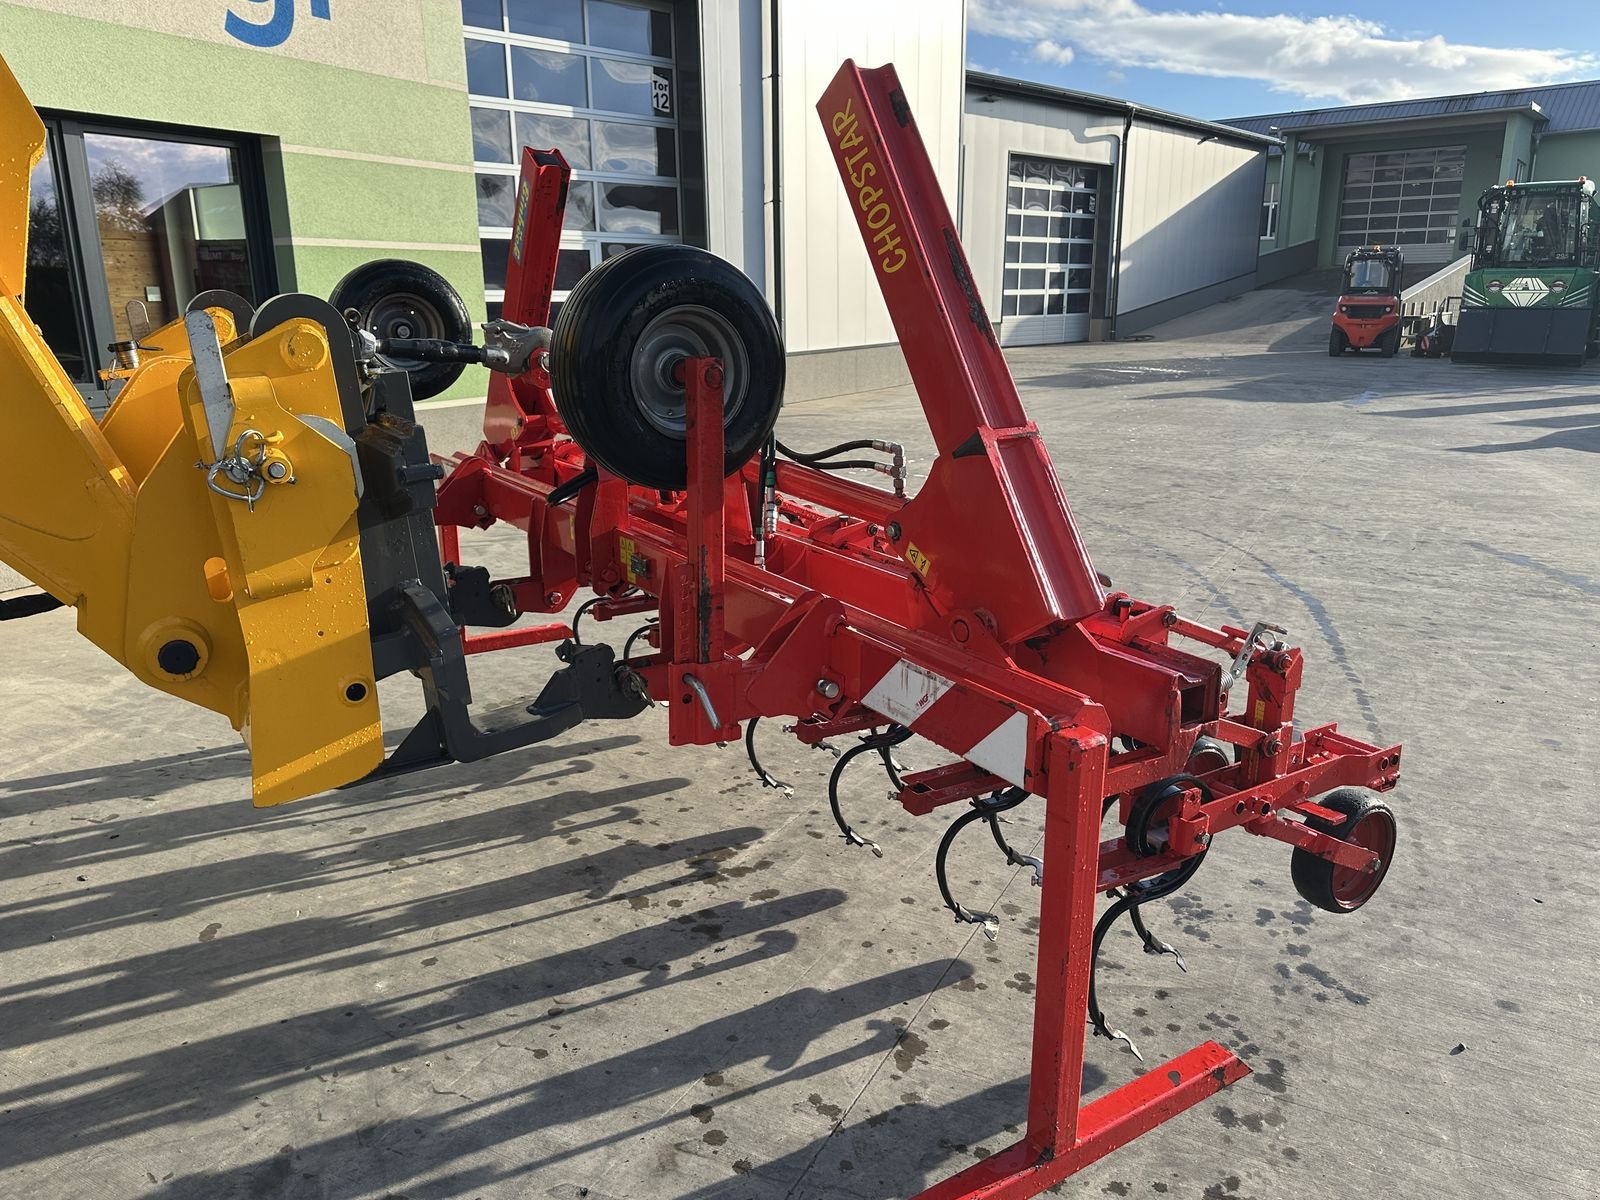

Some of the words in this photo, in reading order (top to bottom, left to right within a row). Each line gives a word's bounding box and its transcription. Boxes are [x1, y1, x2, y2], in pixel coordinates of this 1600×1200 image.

[653, 80, 668, 91] Tor
[653, 92, 669, 109] 12
[832, 98, 907, 273] CHOPSTAR
